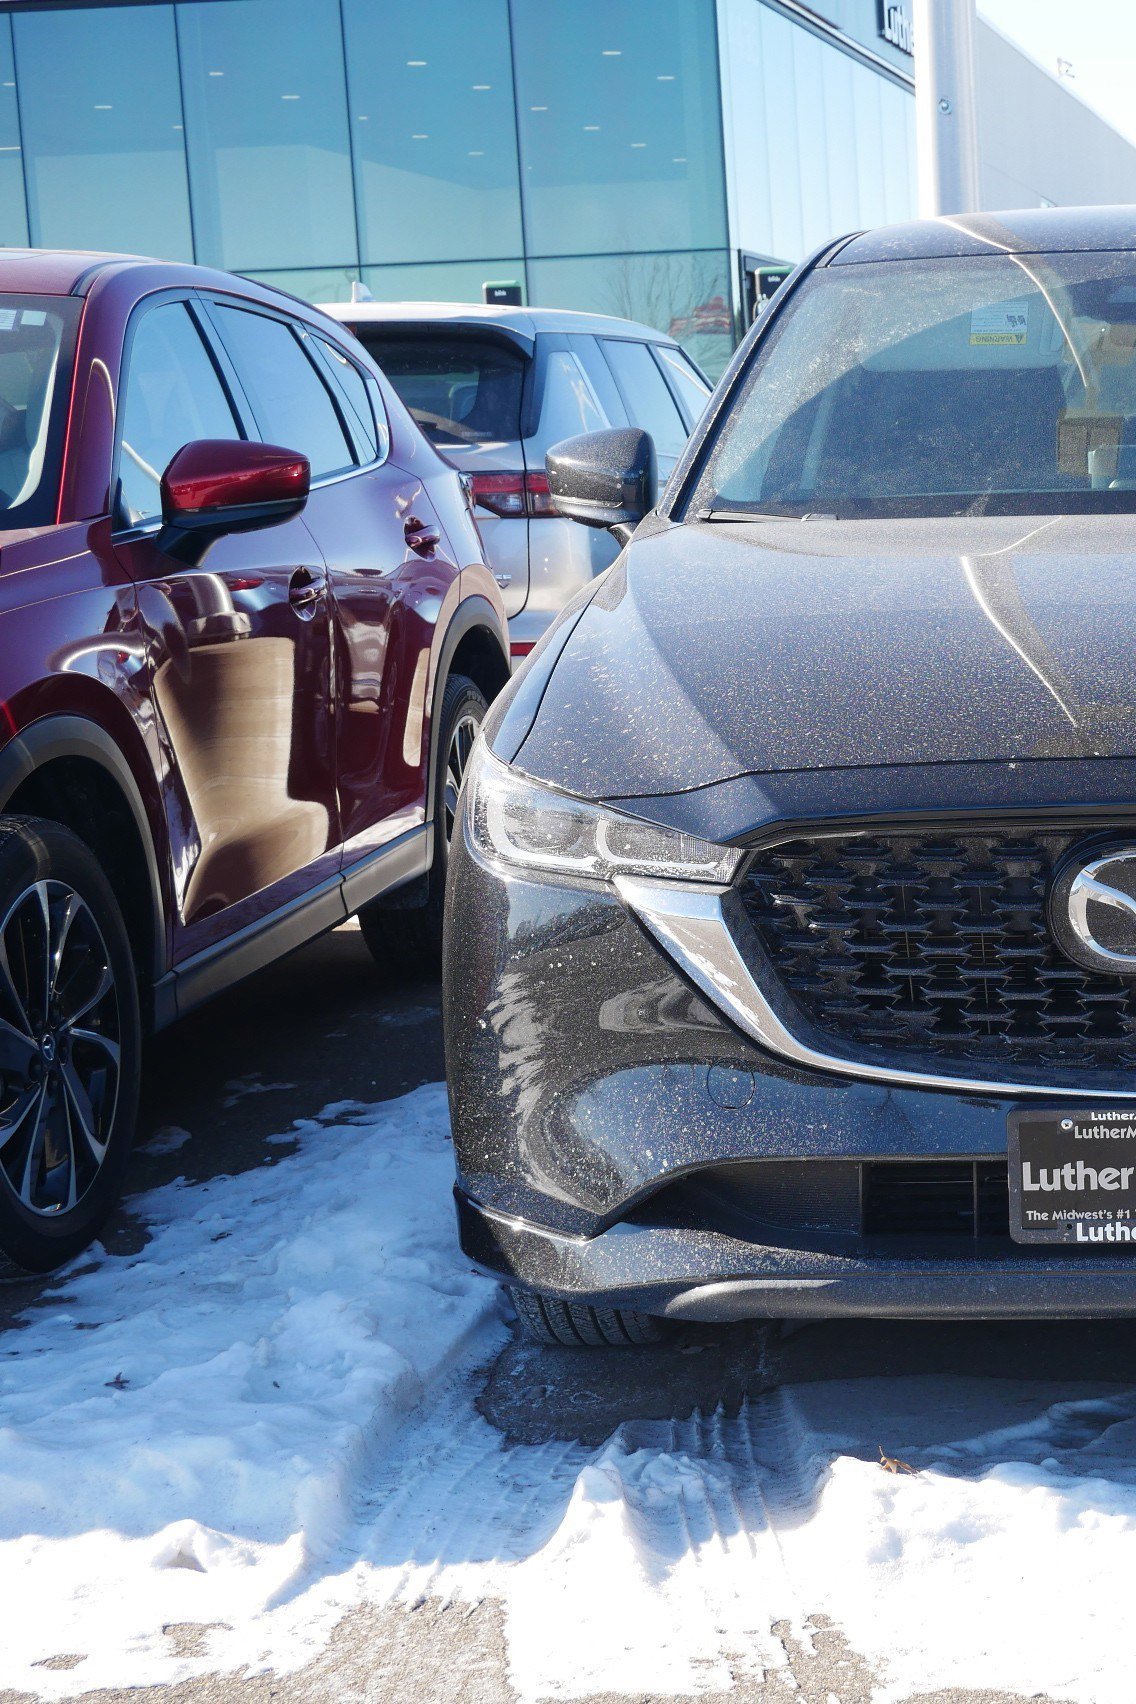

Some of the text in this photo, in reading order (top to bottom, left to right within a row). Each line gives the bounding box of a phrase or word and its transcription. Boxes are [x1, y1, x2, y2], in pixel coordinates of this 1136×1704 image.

[1022, 1160, 1135, 1191] Luther
[1026, 1210, 1049, 1221] The
[1052, 1209, 1113, 1220] Midwest's
[1116, 1209, 1131, 1220] #1
